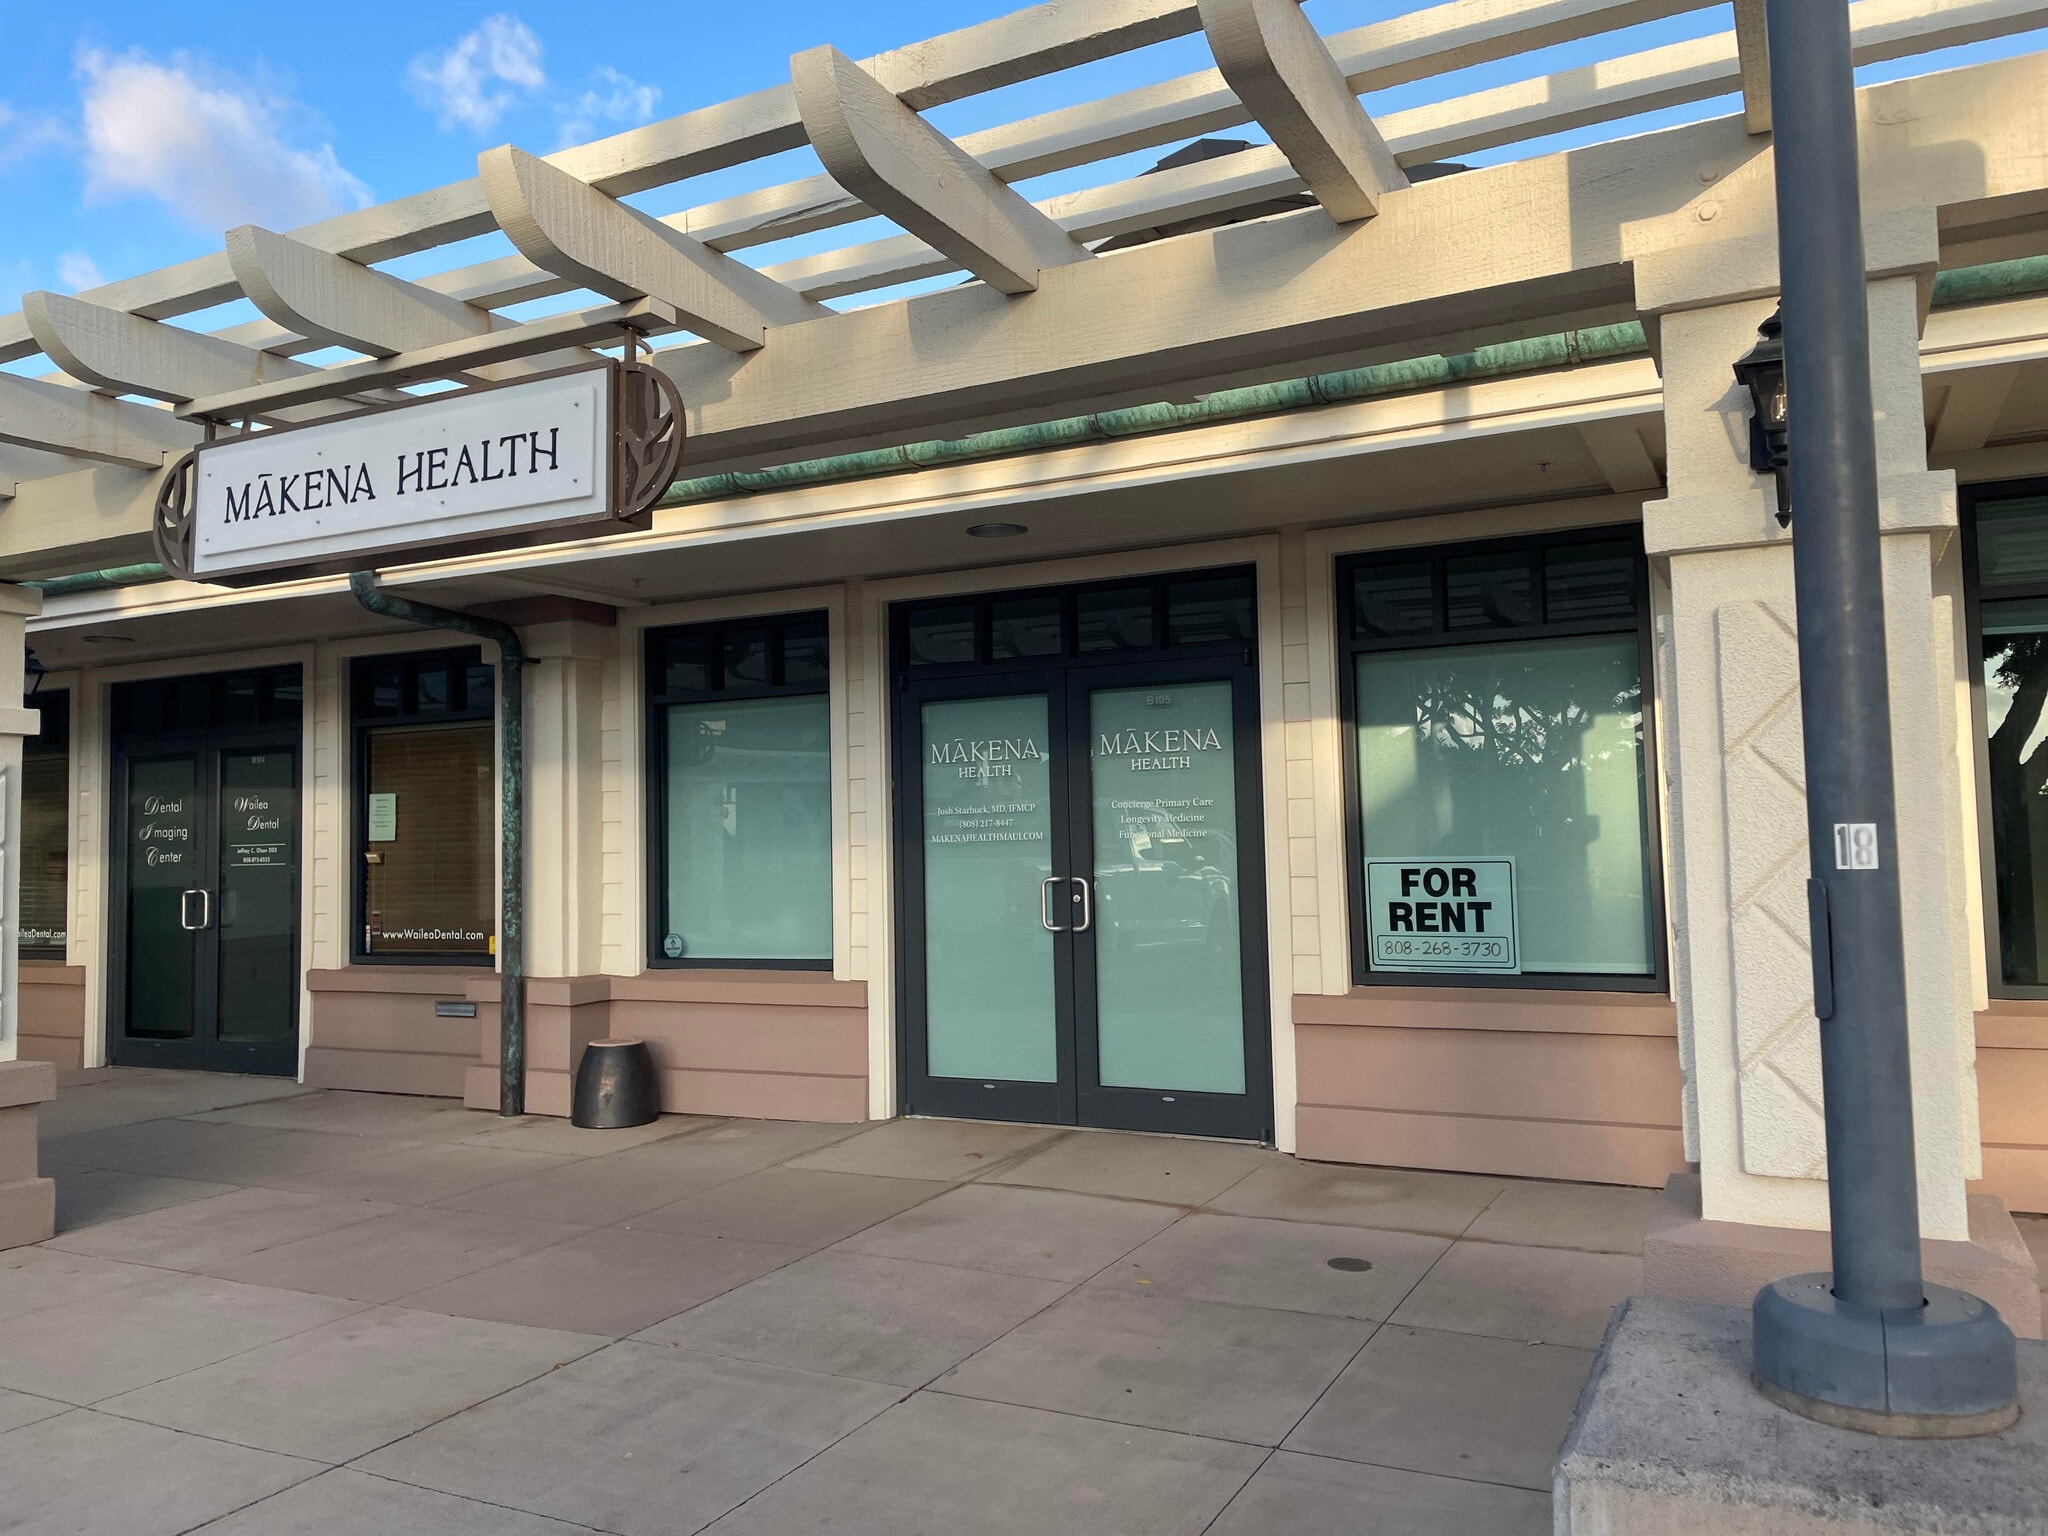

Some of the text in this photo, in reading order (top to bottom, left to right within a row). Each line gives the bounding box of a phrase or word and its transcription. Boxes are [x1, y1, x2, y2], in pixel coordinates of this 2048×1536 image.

[223, 427, 560, 524] MĀKENA HEALTH
[1146, 695, 1171, 706] B105
[1100, 728, 1223, 756] MĀKENA
[930, 738, 1040, 765] MĀKENA
[958, 764, 1012, 779] HEALTH
[1131, 756, 1191, 772] HEALTH
[144, 796, 182, 815] Dental
[234, 795, 269, 812] Wailea
[937, 803, 1036, 817] Josh Starbuck, MD, IFMCP
[1111, 797, 1214, 810] Concierge Primary Care
[247, 815, 280, 831] Dental
[959, 819, 979, 830] (808)
[1120, 812, 1205, 825] Longevity Medicine
[931, 831, 1044, 843] MAKENAHEALTHMAUI.COM
[1166, 828, 1208, 838] Medicine
[1837, 826, 1874, 867] 18
[145, 846, 183, 867] Center
[1401, 868, 1477, 897] FOR
[1389, 901, 1492, 932] RENT
[382, 928, 484, 940] www.WaileaDental.com
[1384, 940, 1502, 957] 808-268-3730
